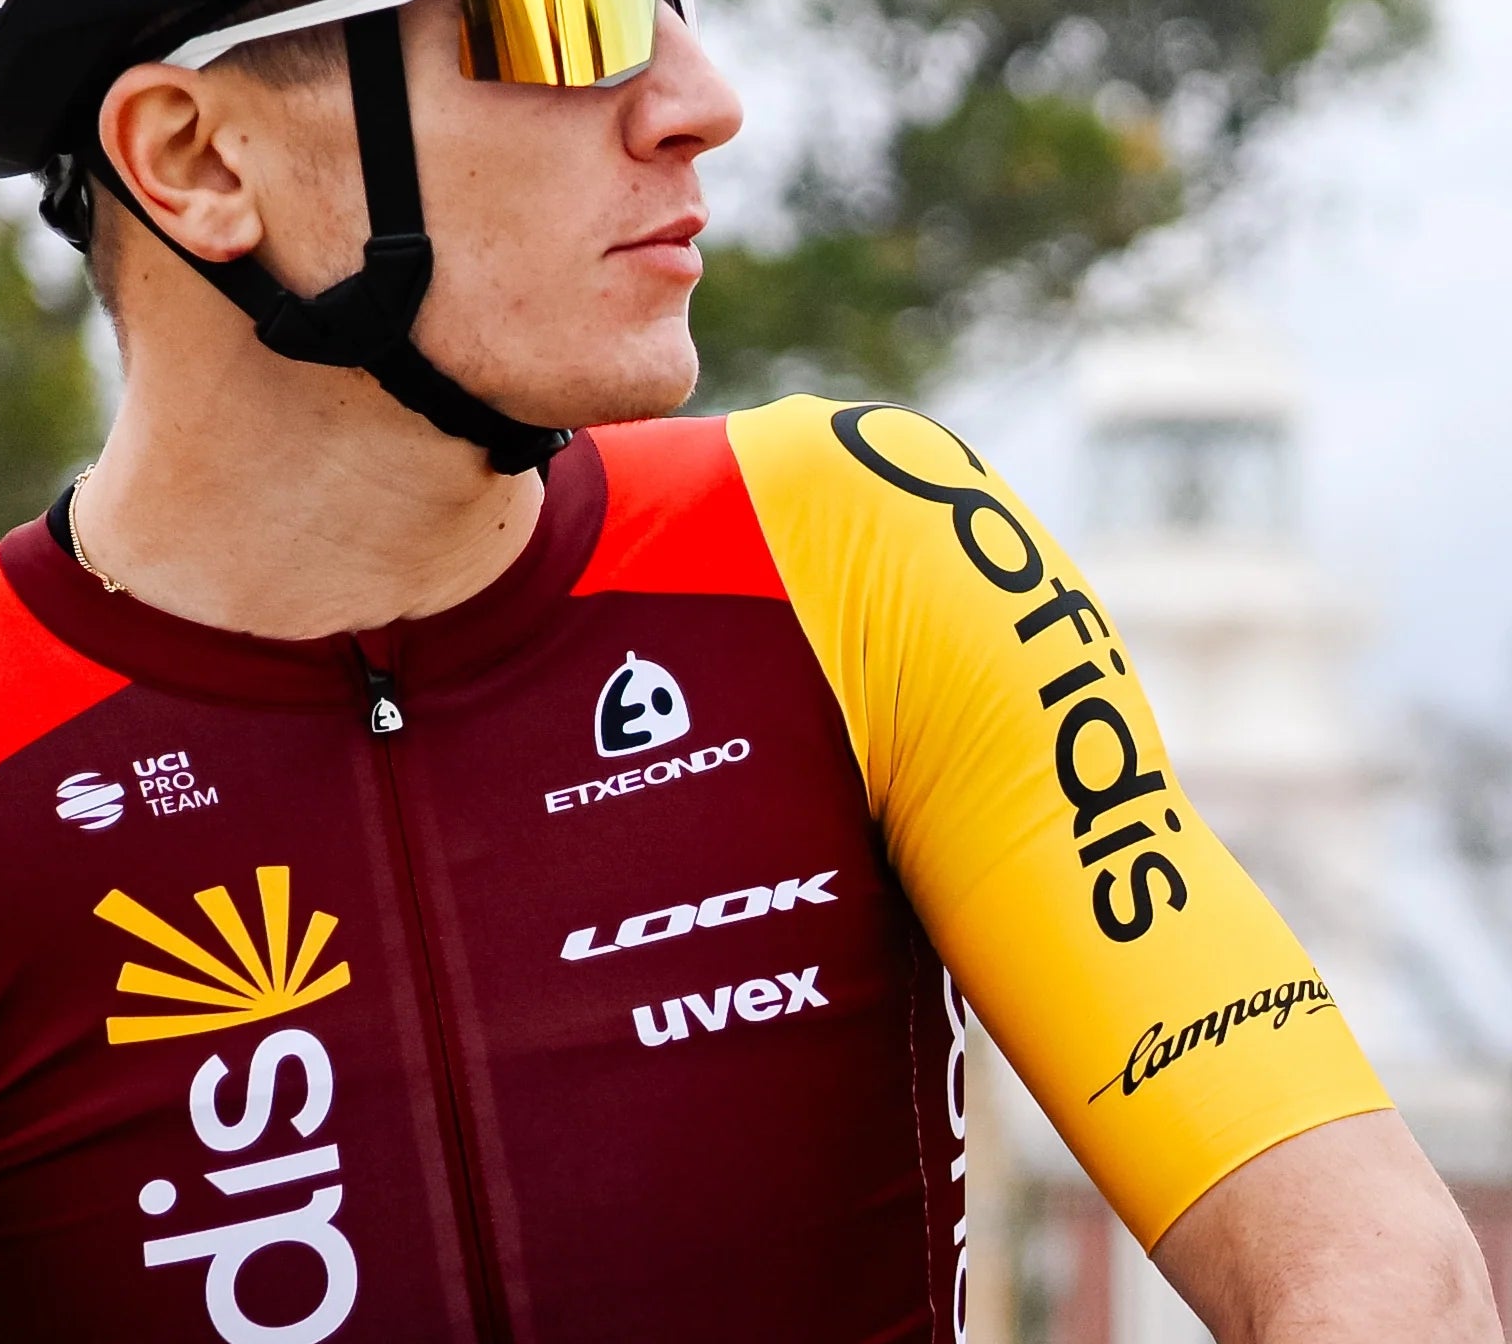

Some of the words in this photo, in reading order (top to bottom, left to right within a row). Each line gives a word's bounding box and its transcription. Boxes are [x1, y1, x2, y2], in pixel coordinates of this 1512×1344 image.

[831, 401, 1187, 944] Cofidis
[132, 751, 190, 777] UCI
[139, 771, 195, 798] PRO
[145, 786, 219, 817] TEAM
[544, 738, 751, 814] ETXEONDO
[560, 869, 839, 961] LOOK
[633, 966, 829, 1048] uvex
[1088, 967, 1337, 1105] Campagno
